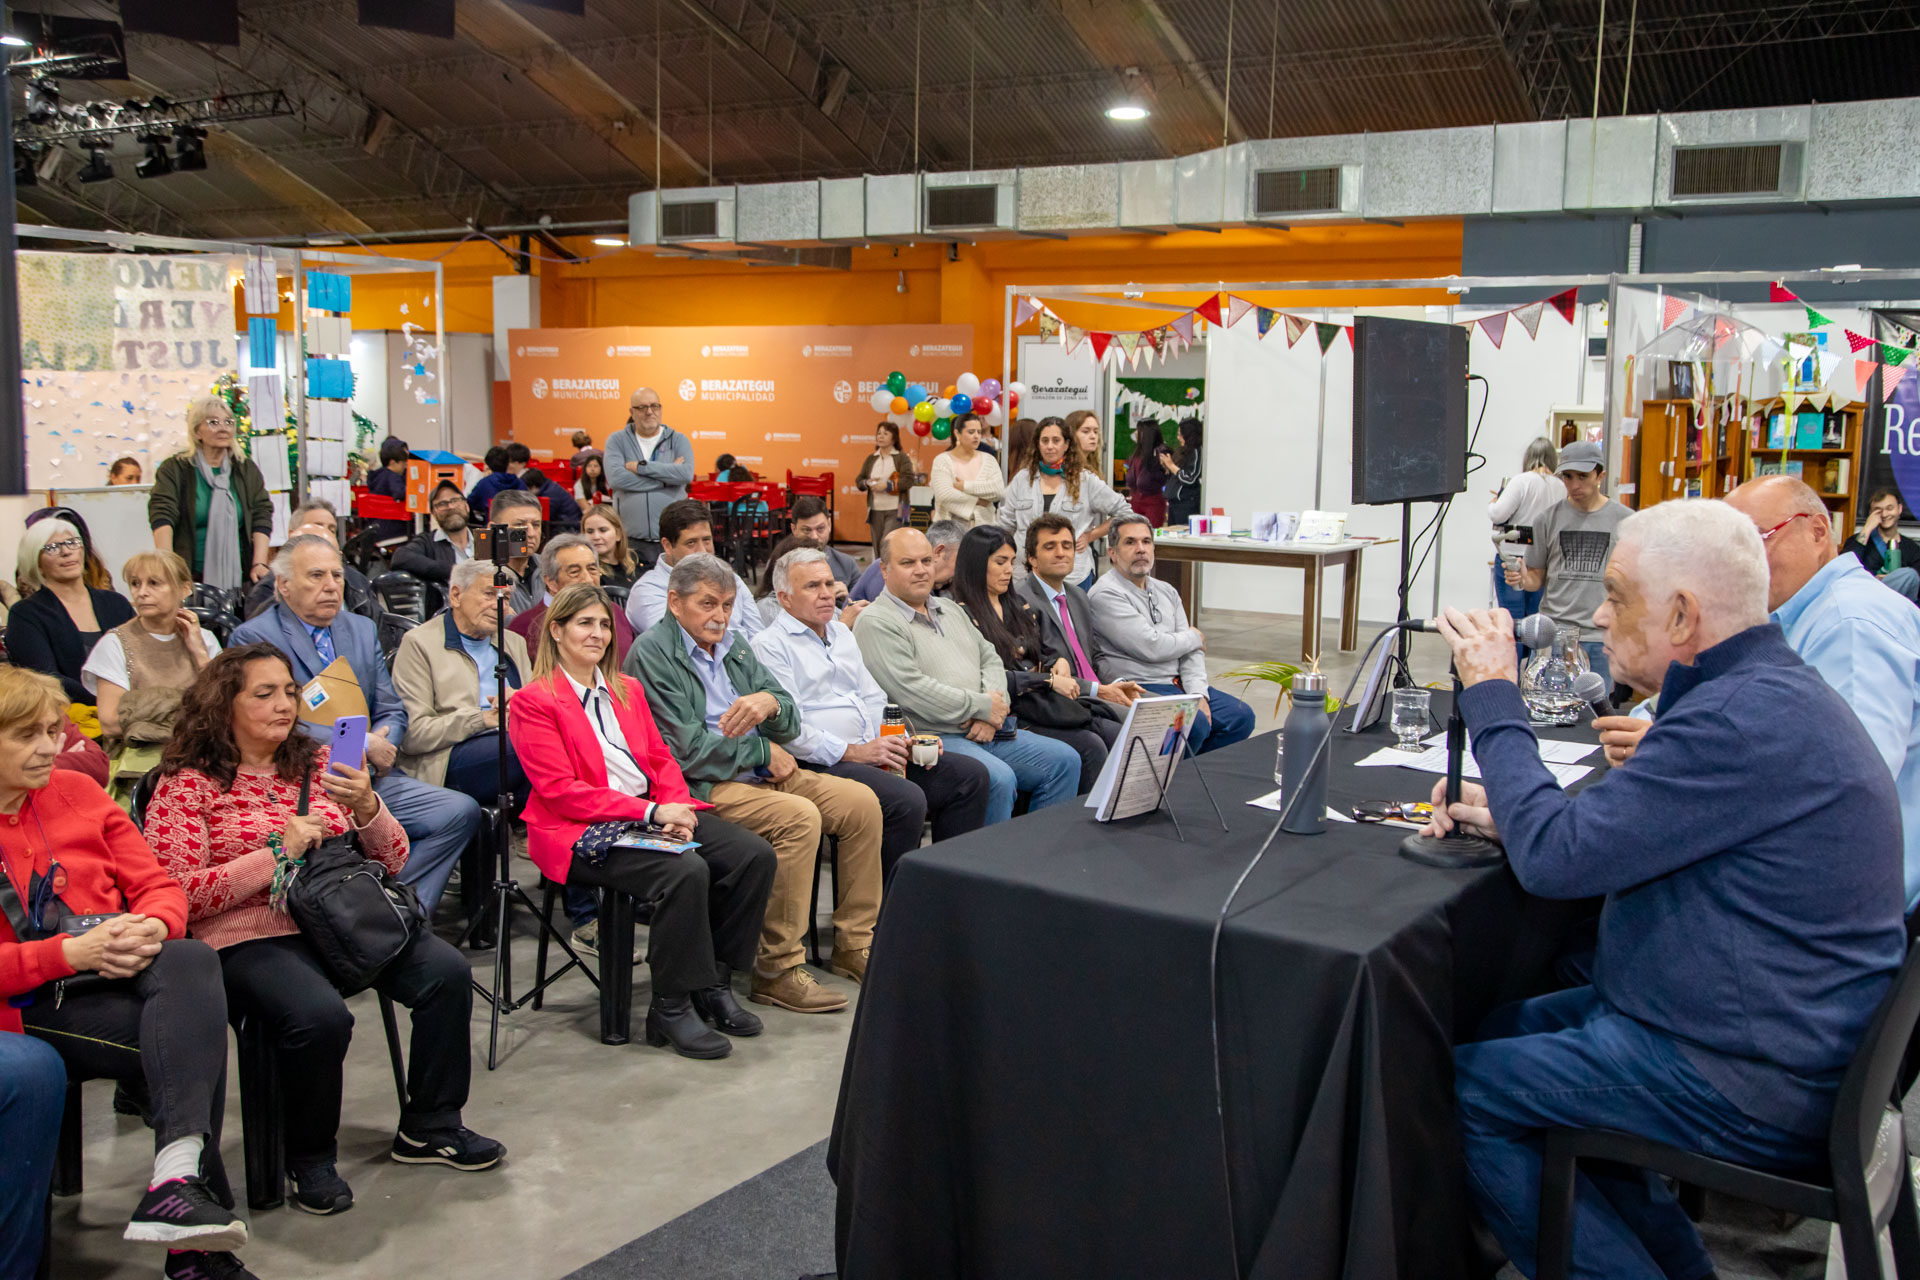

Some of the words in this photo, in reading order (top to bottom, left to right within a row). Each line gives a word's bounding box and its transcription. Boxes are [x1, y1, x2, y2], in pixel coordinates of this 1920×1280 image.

[552, 378, 620, 390] BERAZATEGUI
[701, 380, 774, 392] BERAZATEGUI
[1032, 384, 1088, 396] Berazategui
[553, 390, 620, 400] MUNICIPALIDAD
[702, 392, 775, 402] MUNICIPALIDAD
[1566, 558, 1600, 574] PUMA
